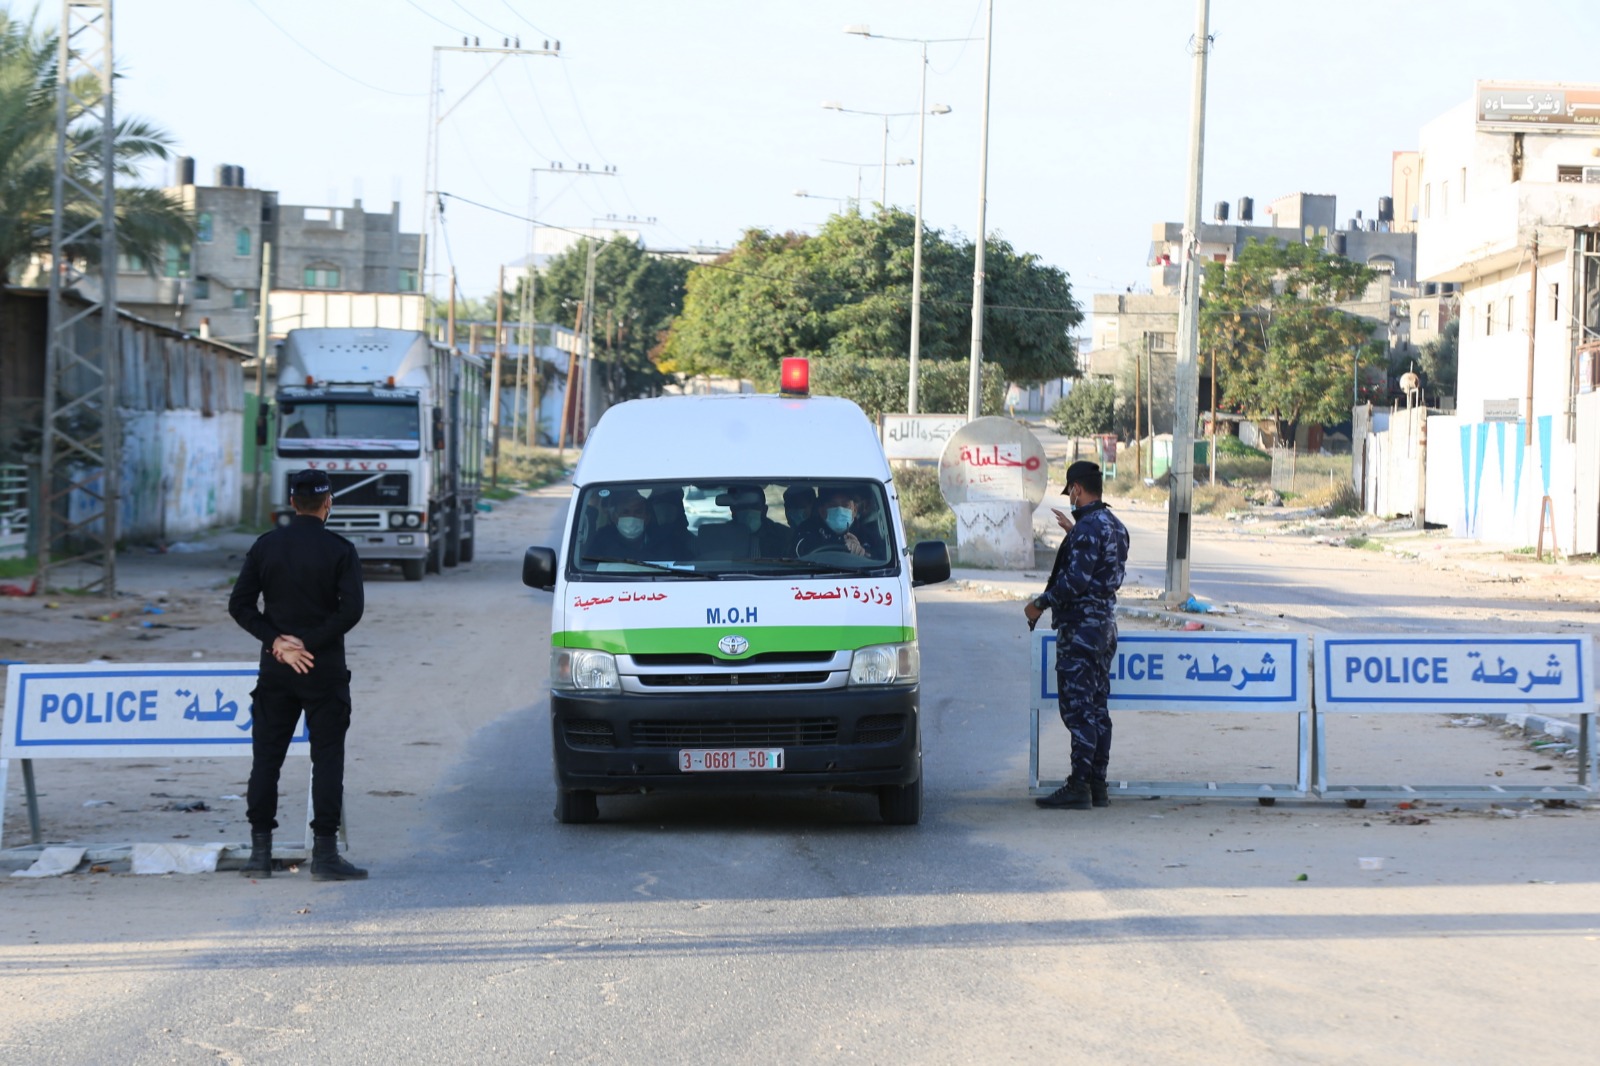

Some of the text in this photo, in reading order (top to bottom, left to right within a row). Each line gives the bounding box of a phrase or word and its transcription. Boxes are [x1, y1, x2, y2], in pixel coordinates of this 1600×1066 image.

[307, 460, 389, 471] VOLVO
[574, 593, 614, 610] صحية
[790, 585, 893, 606] وزارة الصحة
[706, 607, 758, 624] M.O.H
[1109, 653, 1164, 681] ICE
[1177, 651, 1276, 691] شرطة
[1345, 656, 1448, 684] POLICE
[1467, 650, 1562, 693] شرطة
[39, 689, 158, 725] POLICE
[174, 687, 252, 732] رطة
